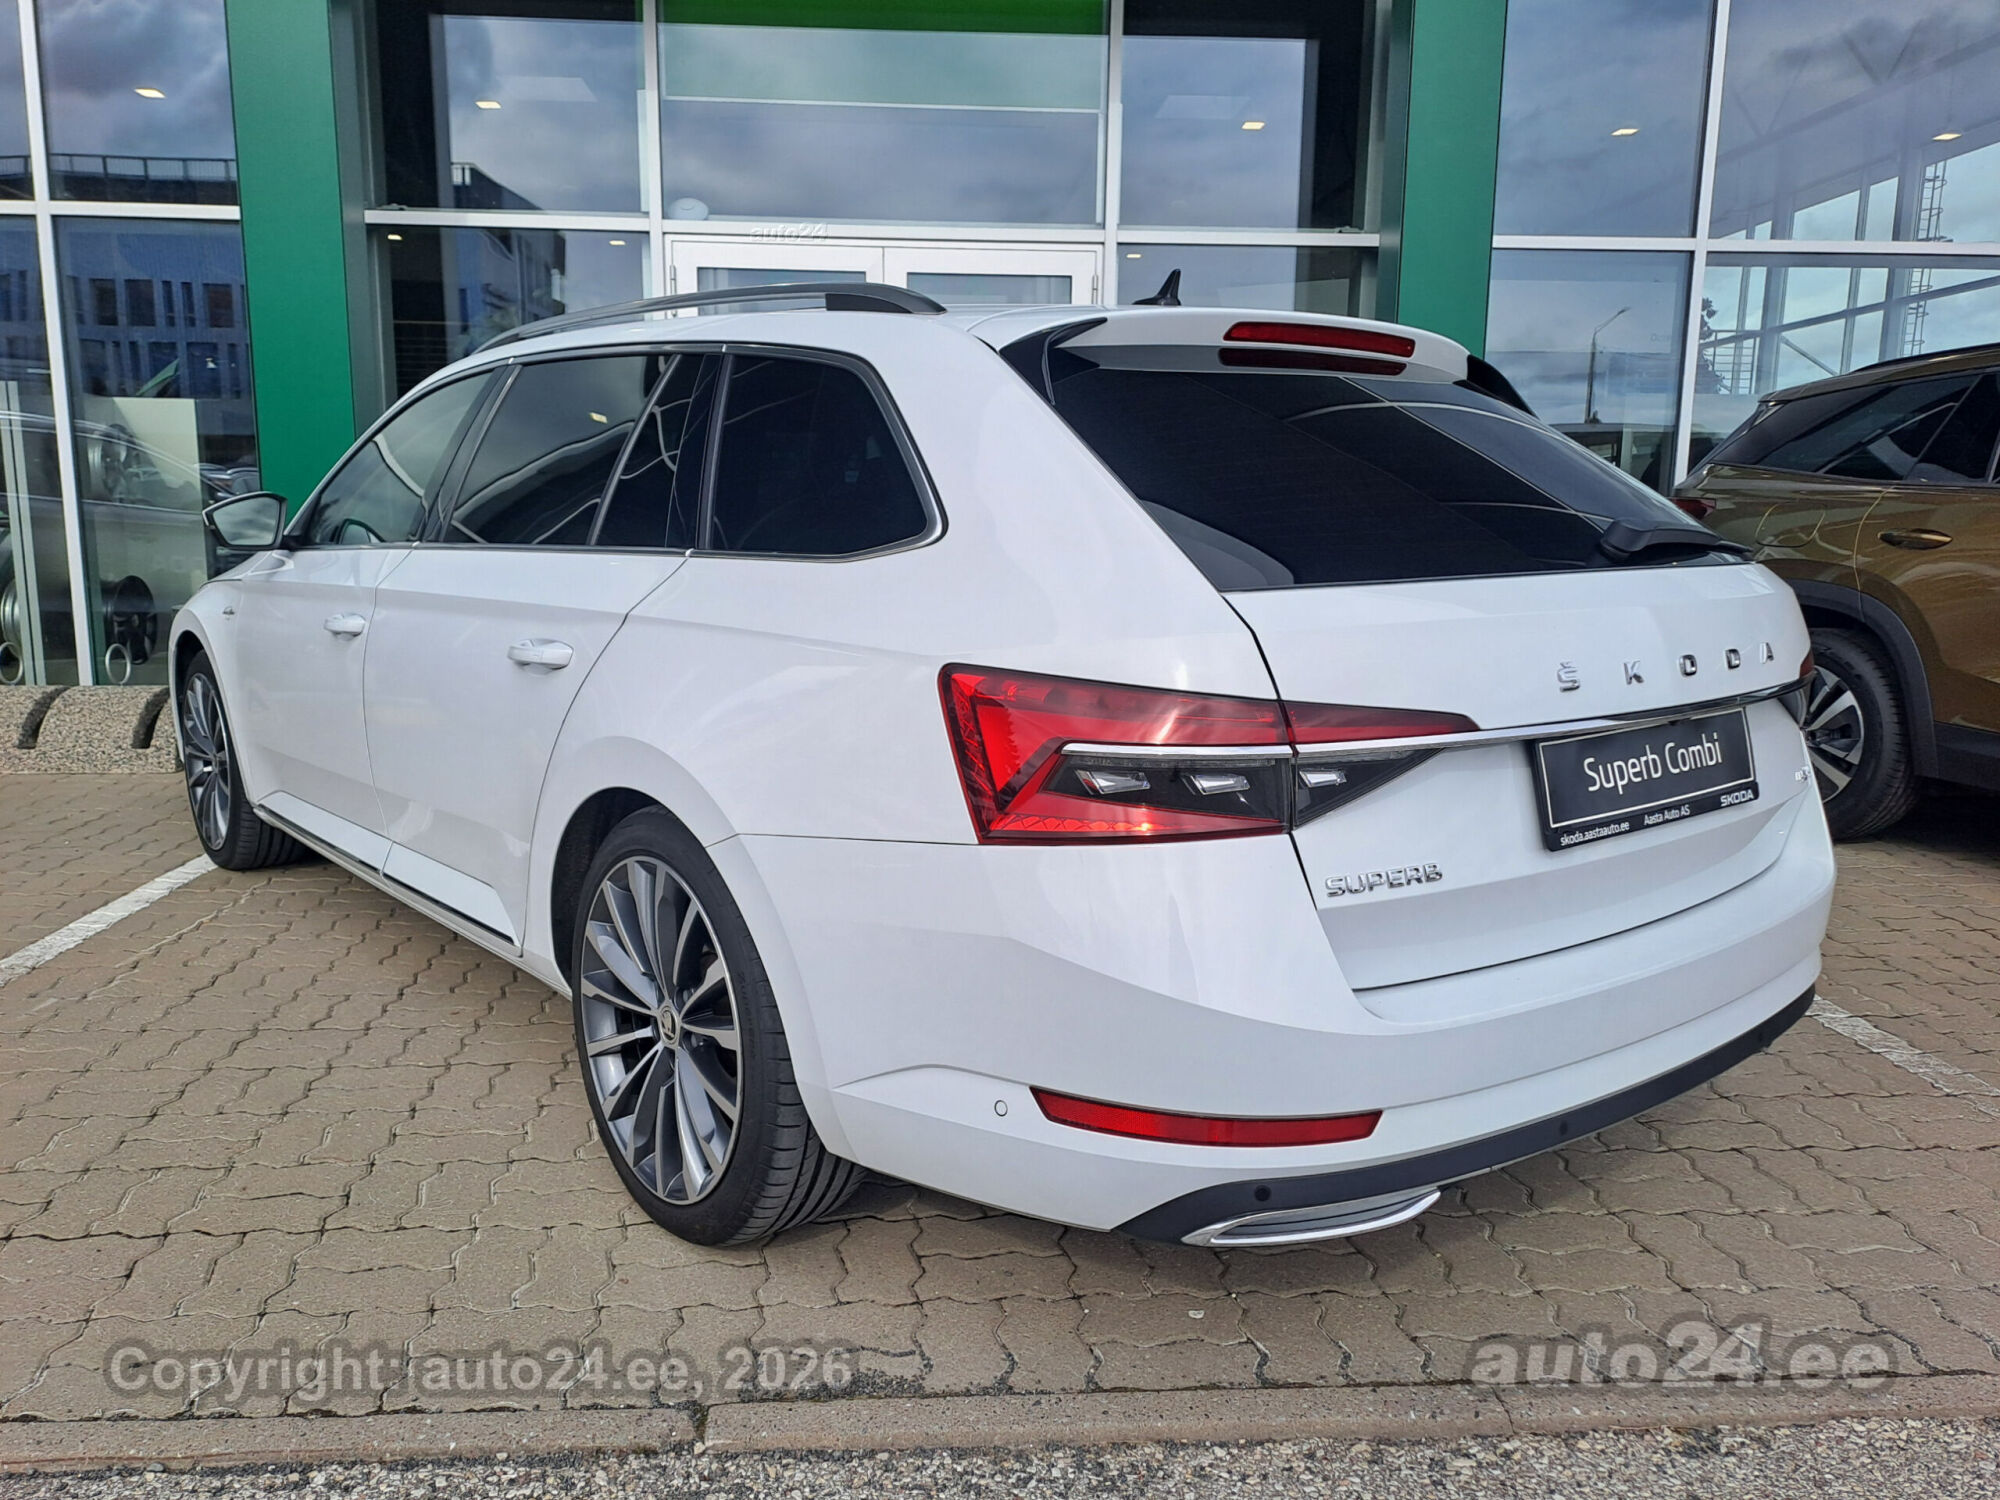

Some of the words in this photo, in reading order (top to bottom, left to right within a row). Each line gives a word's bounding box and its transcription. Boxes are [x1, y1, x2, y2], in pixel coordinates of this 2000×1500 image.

[1583, 744, 1661, 795] Superb
[1664, 732, 1723, 773] Combi
[1643, 811, 1663, 825] Aasta
[1663, 807, 1680, 821] Auto
[1680, 804, 1691, 816] AS
[1560, 821, 1630, 846] skoda.aastaauto.ee
[1325, 862, 1443, 898] SUPERB
